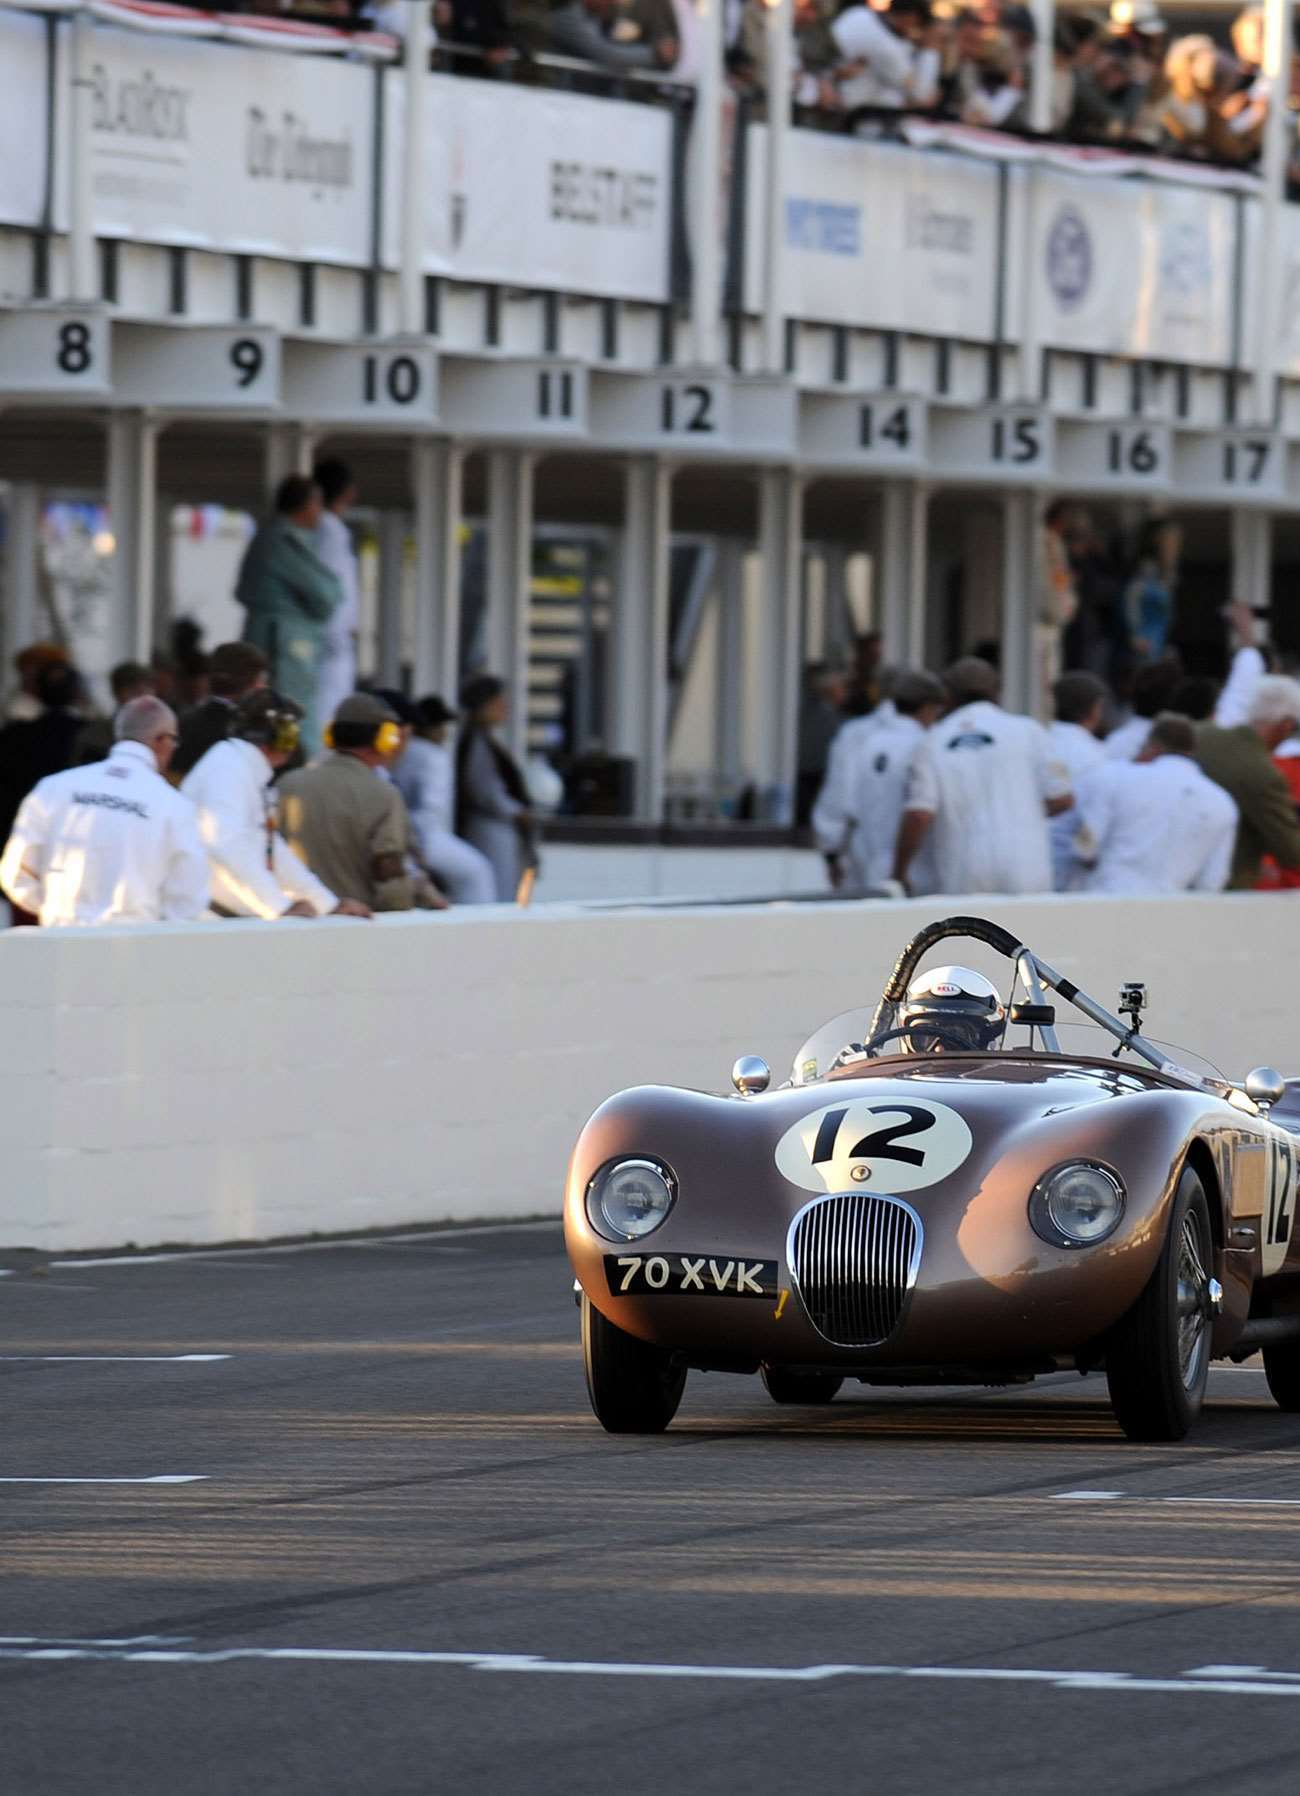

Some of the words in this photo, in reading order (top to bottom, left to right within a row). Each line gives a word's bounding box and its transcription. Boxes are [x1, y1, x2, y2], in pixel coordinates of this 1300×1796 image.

[57, 322, 91, 374] 8
[229, 339, 264, 387] 9
[364, 355, 420, 405] 10
[537, 370, 572, 419] 11
[661, 386, 715, 433] 12
[859, 403, 910, 448] 14
[992, 418, 1040, 462] 15
[1108, 430, 1158, 474] 16
[1222, 442, 1270, 483] 17
[811, 1105, 936, 1168] 12
[1267, 1141, 1291, 1245] 12
[617, 1256, 670, 1291] 70
[680, 1257, 765, 1294] XVK
